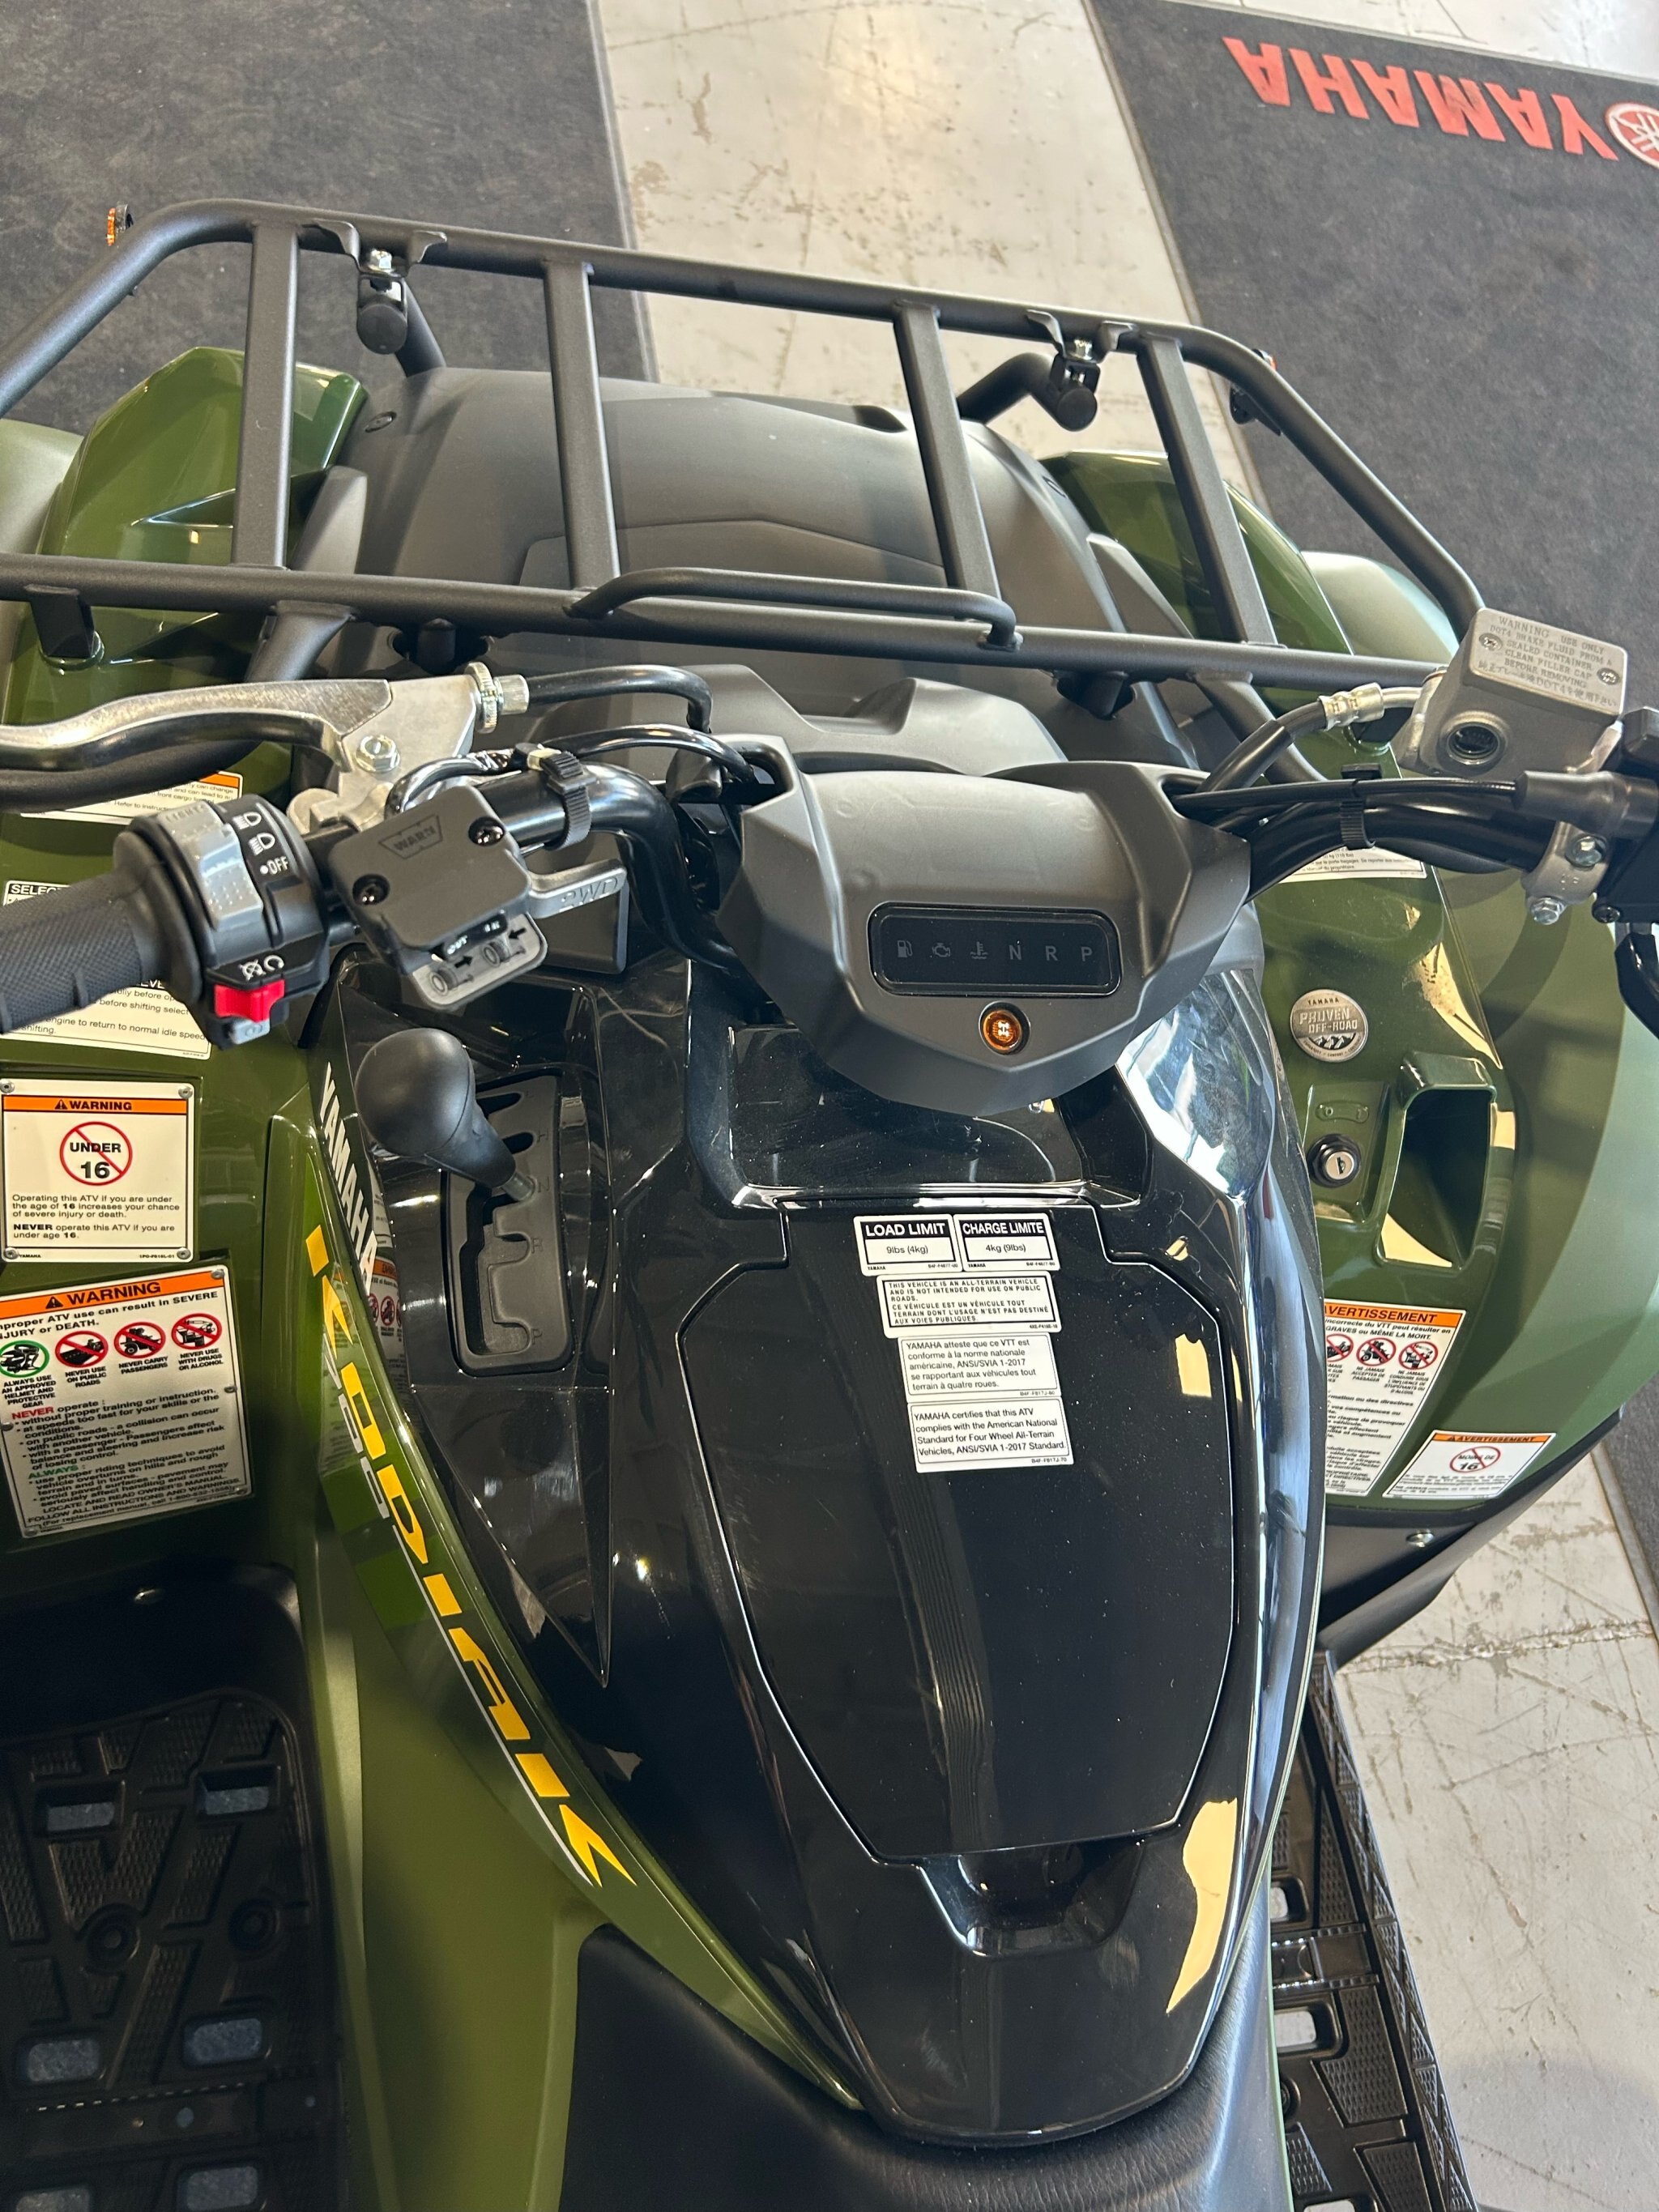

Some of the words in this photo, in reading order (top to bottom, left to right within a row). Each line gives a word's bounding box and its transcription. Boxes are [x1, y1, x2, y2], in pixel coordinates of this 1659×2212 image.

[1222, 36, 1618, 161] YAMAHA
[1499, 616, 1549, 637] WARNING
[1561, 635, 1577, 646] USE
[1581, 641, 1604, 654] ONLY
[1507, 640, 1540, 654] SEALED
[1543, 650, 1591, 670] CONTAINER
[1504, 649, 1533, 663] CLEAN
[1537, 658, 1570, 674] FILLER
[1574, 669, 1592, 680] CAP
[210, 785, 233, 794] change
[267, 855, 288, 874] OFF
[1009, 944, 1022, 961] N
[1046, 946, 1058, 961] R
[1081, 946, 1093, 961] P
[134, 990, 162, 999] before
[1307, 997, 1339, 1005] YAMAHA
[130, 1002, 161, 1013] shifting
[1299, 1008, 1350, 1025] PROVEN
[89, 1021, 116, 1029] return
[130, 1025, 160, 1035] normal
[162, 1028, 177, 1037] idle
[1308, 1019, 1358, 1034] OFF-ROAD
[70, 1100, 132, 1110] WARNING
[70, 1142, 121, 1153] UNDER
[80, 1161, 110, 1178] 16
[320, 1061, 377, 1296] YAMAHA
[12, 1194, 58, 1203] Operating
[865, 1224, 905, 1236] LOAD
[908, 1222, 945, 1235] LIMIT
[962, 1222, 1008, 1234] CHARGE
[1009, 1221, 1044, 1234] LIMITE
[886, 1246, 905, 1254] 9lbs
[906, 1245, 928, 1255] (4kg)
[985, 1244, 1001, 1253] 4kg
[1003, 1243, 1026, 1253] (9lbs)
[66, 1281, 161, 1305] WARNING
[47, 1313, 70, 1323] ATV
[74, 1311, 94, 1319] use
[122, 1301, 156, 1311] result
[173, 1291, 217, 1304] SEVERE
[1324, 1306, 1437, 1323] VERTISSEMENT
[55, 1319, 99, 1331] DEATH.
[906, 1341, 942, 1349] YAMAHA
[1000, 1338, 1015, 1346] VTT
[907, 1352, 945, 1360] conforme
[990, 1348, 1025, 1356] nationale
[957, 1359, 998, 1368] ANSI/SVIA
[1000, 1357, 1026, 1366] 1-2017
[11, 1406, 54, 1420] NEVER
[57, 1401, 99, 1412] operate
[914, 1412, 950, 1421] YAMAHA
[952, 1411, 983, 1419] certifies
[984, 1409, 1000, 1417] that
[915, 1424, 952, 1433] complies
[953, 1422, 970, 1430] with
[972, 1421, 985, 1430] the
[987, 1421, 1024, 1429] American
[1026, 1418, 1057, 1426] National
[917, 1434, 953, 1444] Standard
[988, 1431, 1013, 1440] Wheel
[1015, 1430, 1054, 1438] All-Terrain
[918, 1447, 954, 1455] Vehicles,
[956, 1443, 998, 1453] ANSI/SVIA
[1000, 1443, 1026, 1451] 1-2017
[1029, 1441, 1066, 1450] Standard.
[1461, 1462, 1480, 1470] 16
[305, 1225, 638, 1888] KODIAK
